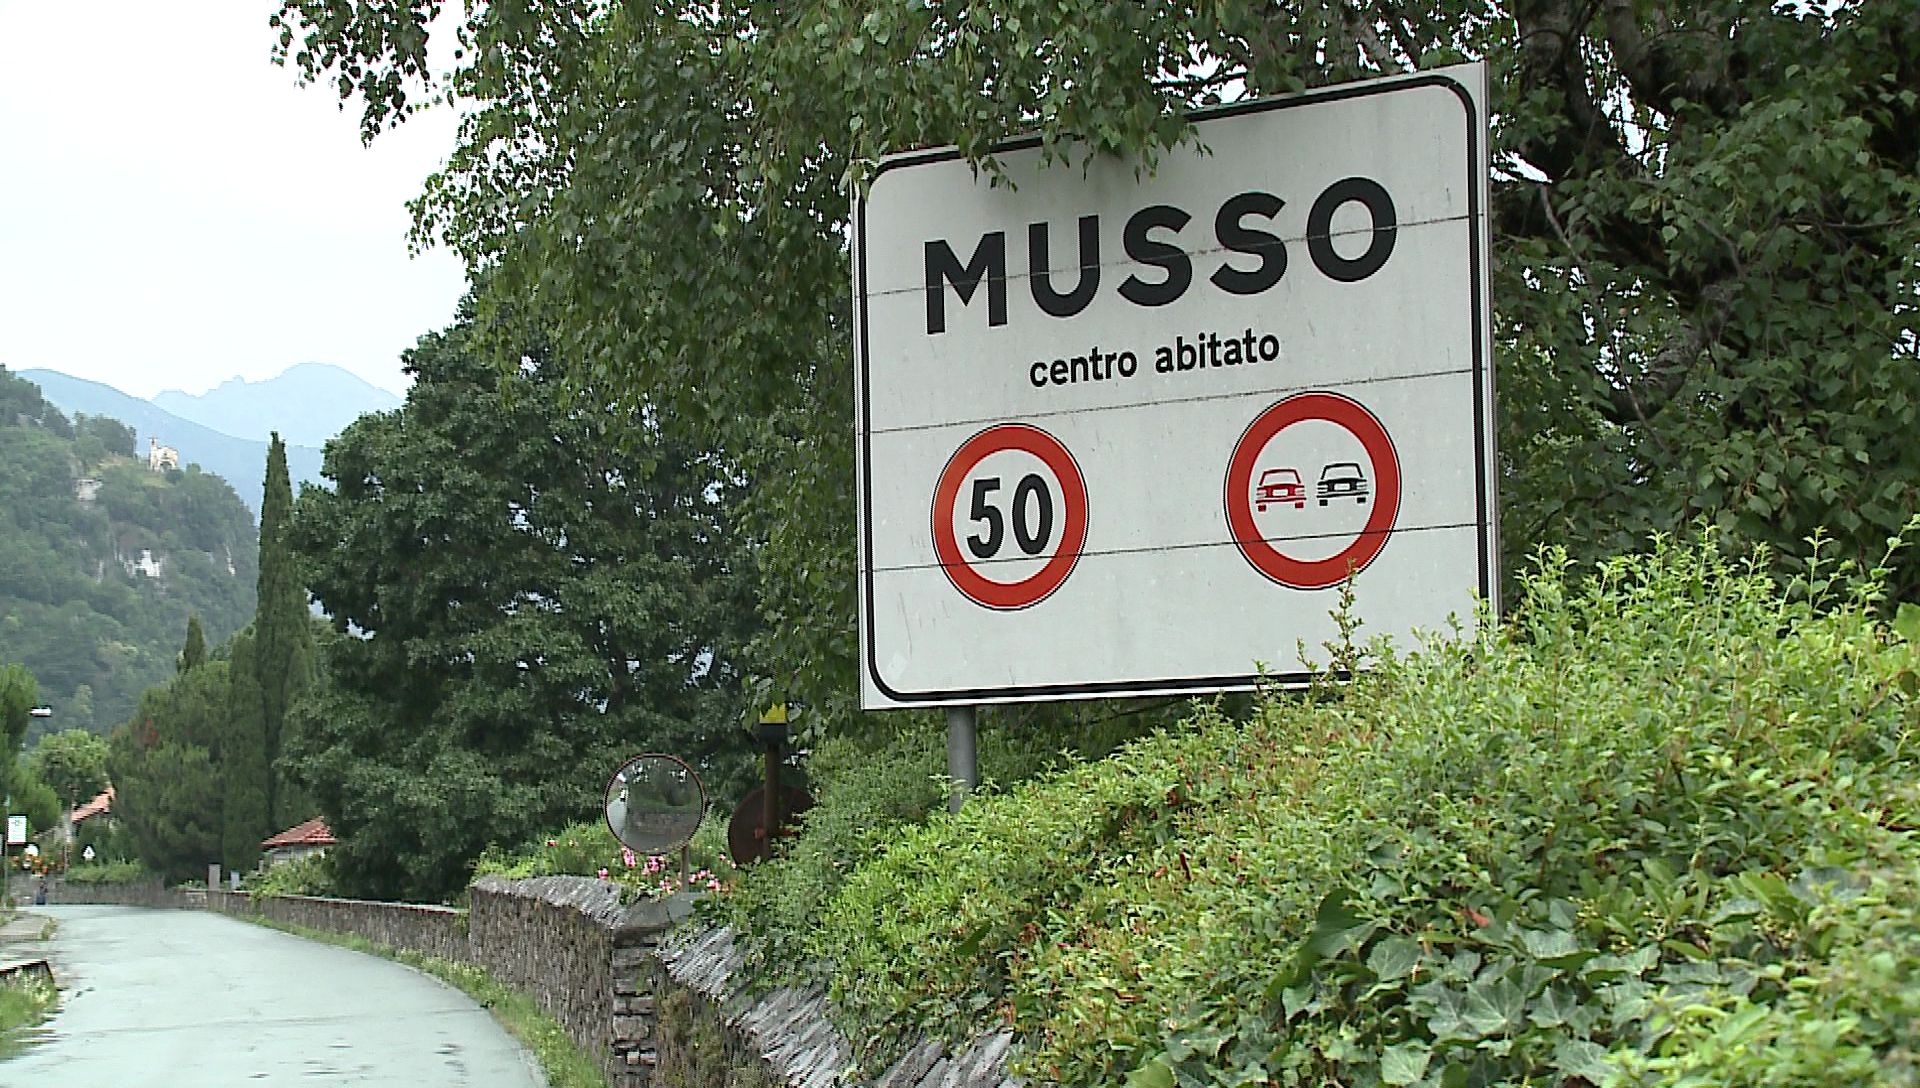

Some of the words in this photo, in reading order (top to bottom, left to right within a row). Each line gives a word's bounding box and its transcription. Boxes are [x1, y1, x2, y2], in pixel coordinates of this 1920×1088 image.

[924, 176, 1398, 335] MUSSO
[1030, 346, 1137, 387] centro
[1155, 328, 1280, 373] abitato
[966, 473, 1053, 559] 50
